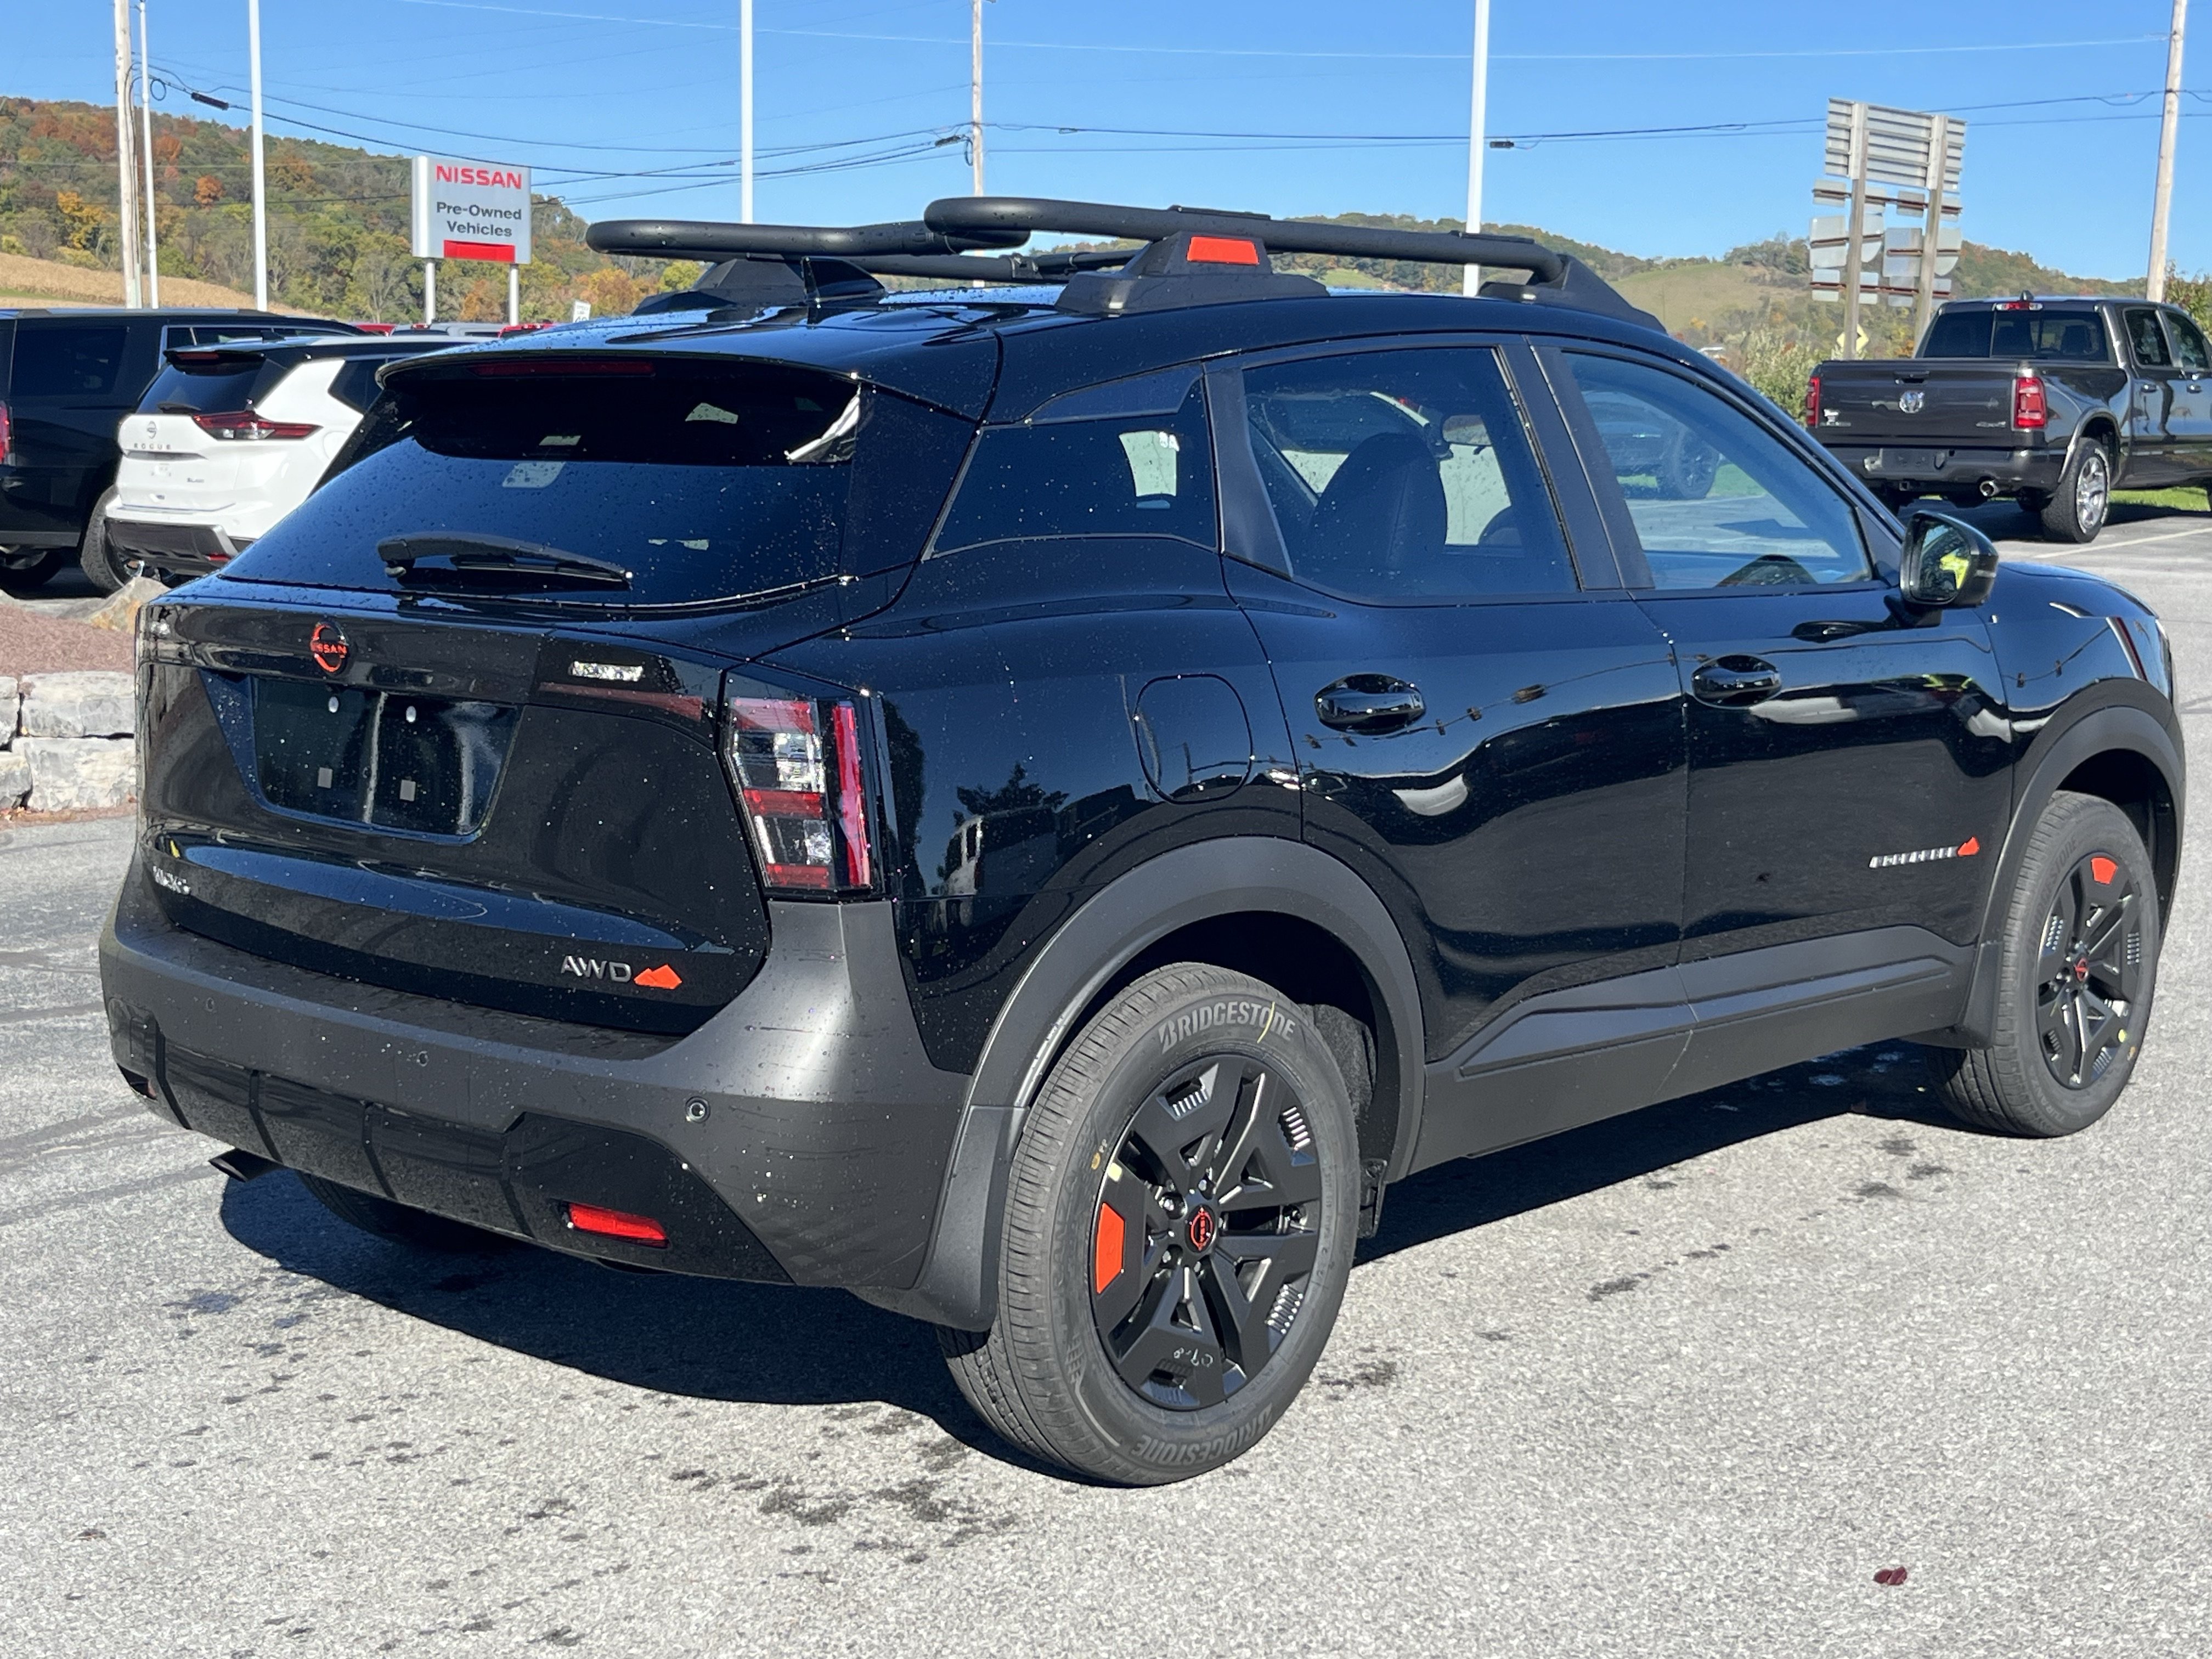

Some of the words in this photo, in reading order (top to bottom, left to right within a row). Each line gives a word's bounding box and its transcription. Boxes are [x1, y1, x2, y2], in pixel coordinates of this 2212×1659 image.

[436, 165, 522, 189] NISSAN
[437, 201, 522, 220] Pre-Owned
[447, 221, 512, 237] Vehicles
[561, 955, 631, 983] AWD
[1158, 1001, 1296, 1054] BRIDGESTONE
[1131, 1402, 1273, 1466] BRIDGESTONE
